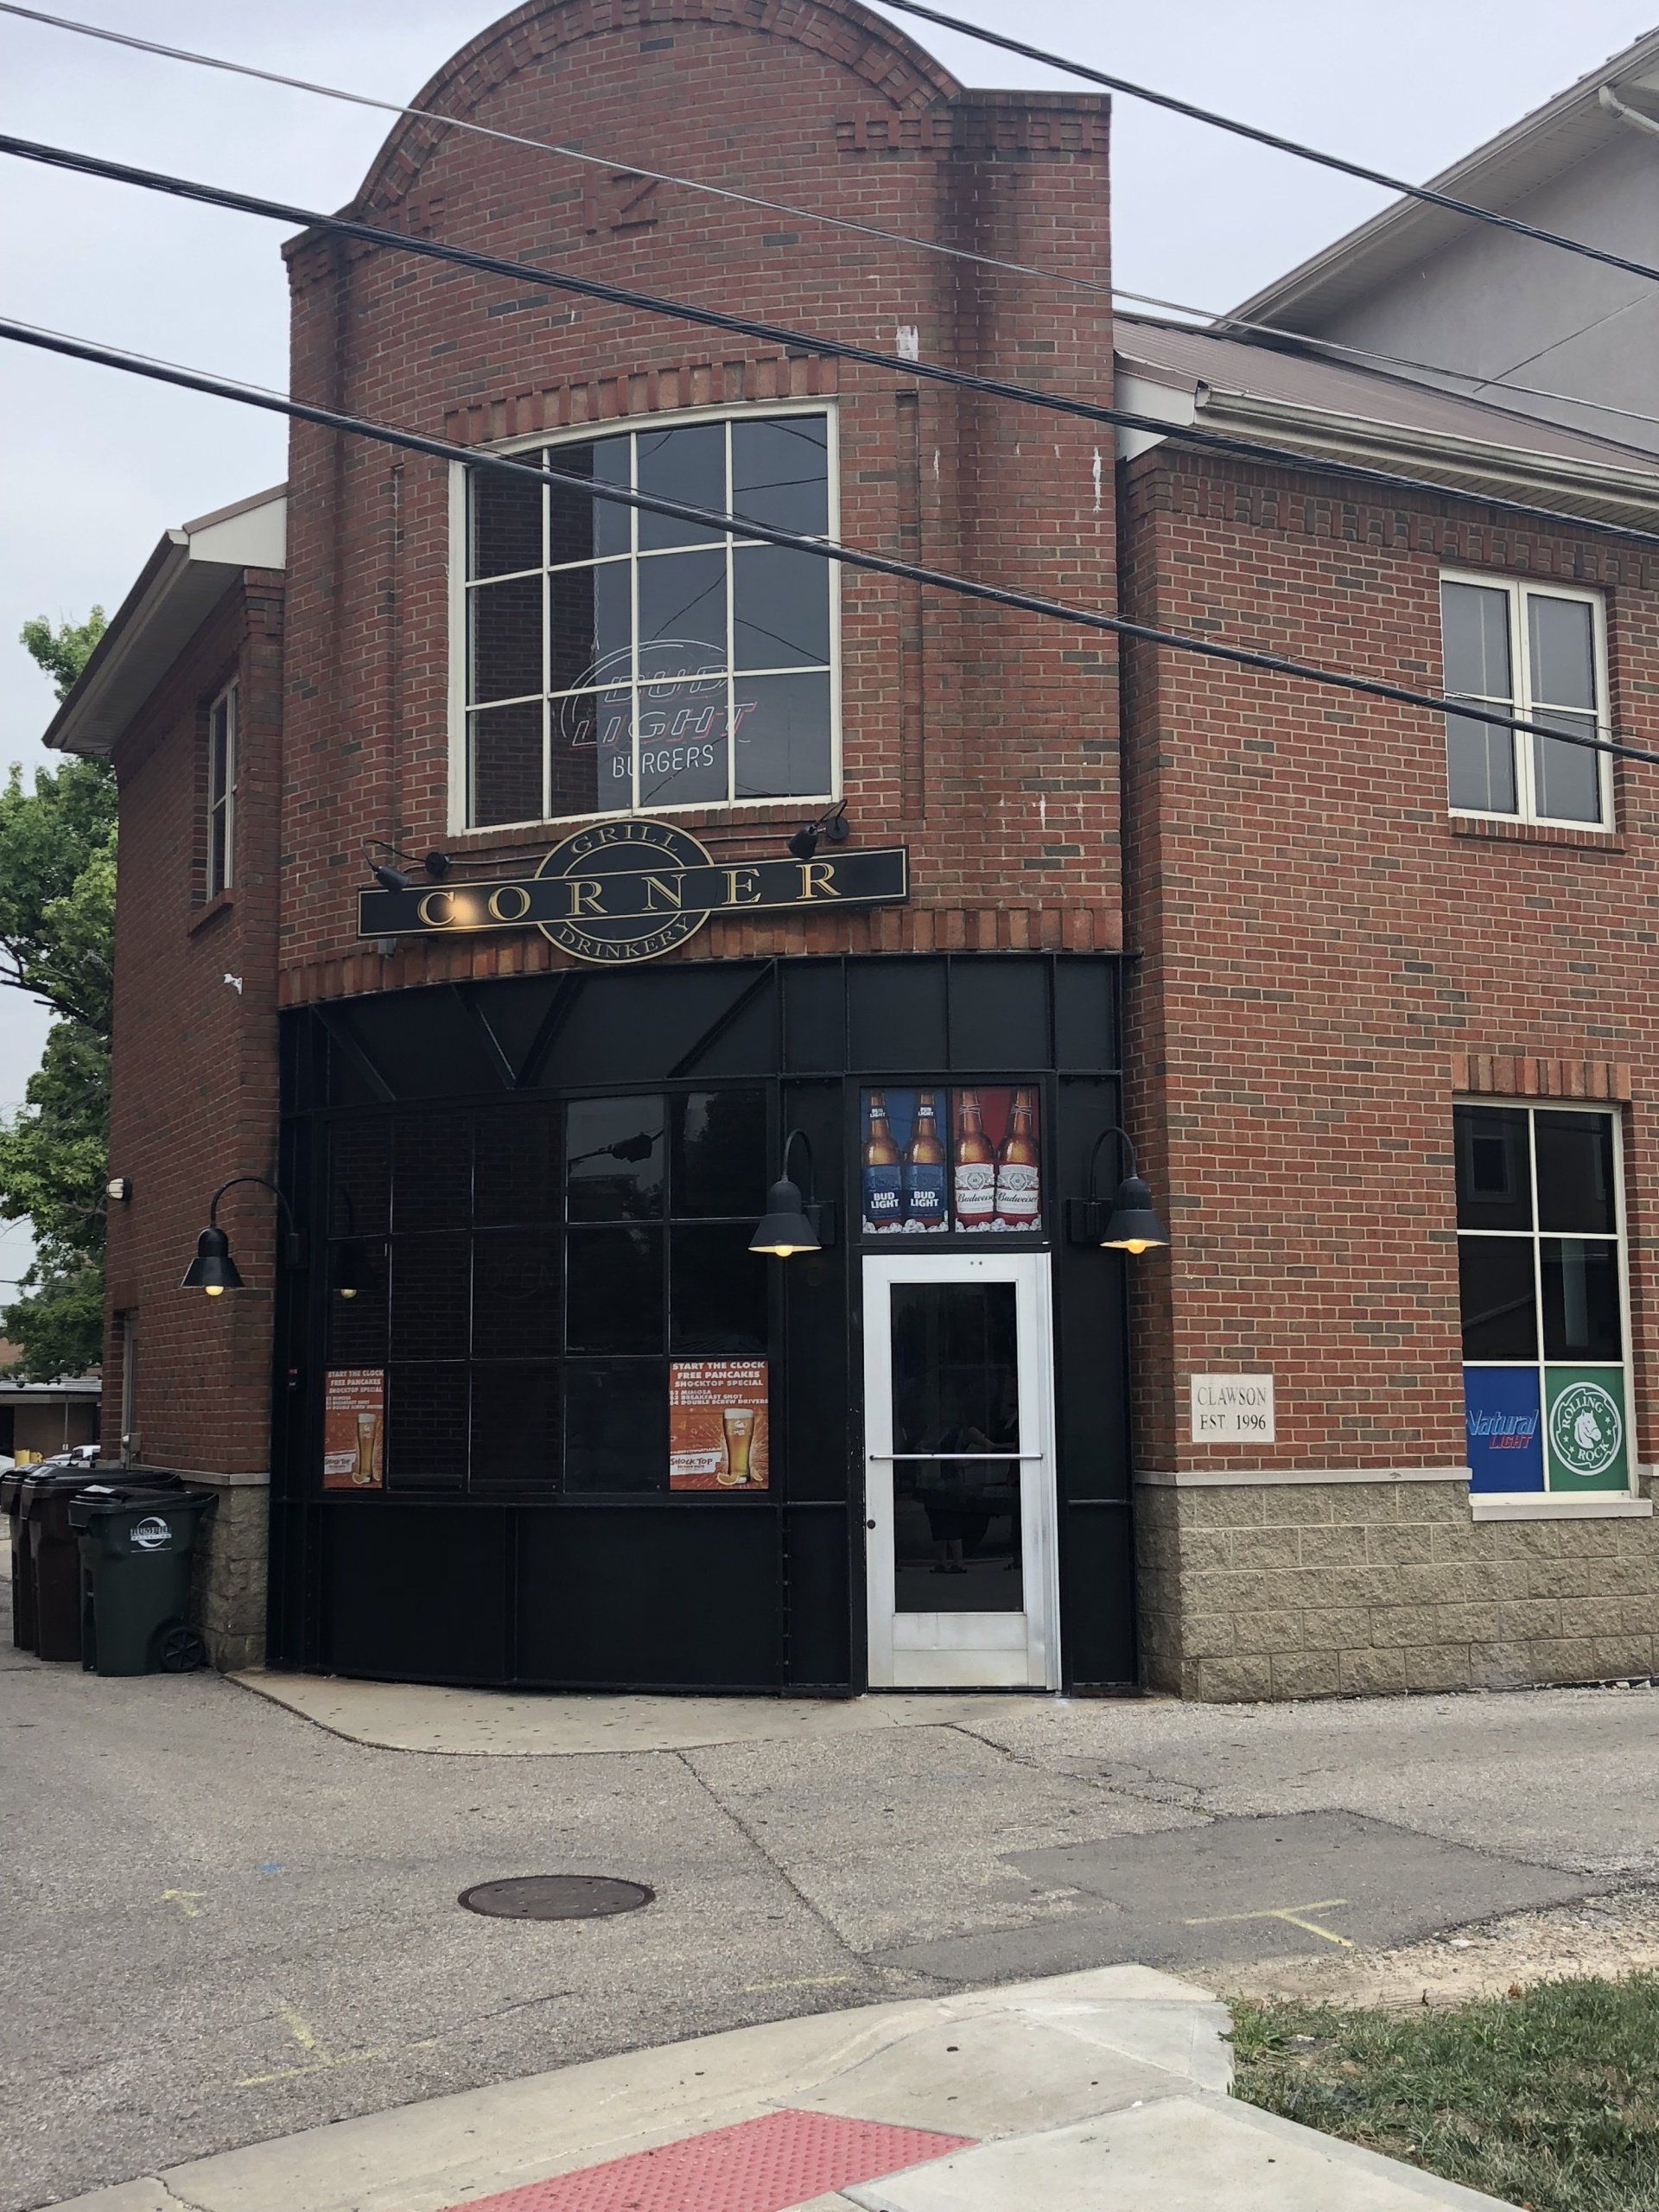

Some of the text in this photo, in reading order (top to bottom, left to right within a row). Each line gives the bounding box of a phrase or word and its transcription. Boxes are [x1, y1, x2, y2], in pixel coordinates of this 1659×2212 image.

[571, 702, 758, 750] LIGHT
[612, 744, 715, 779] BURGERS
[570, 823, 678, 855] GRILL
[417, 862, 842, 927] CORNER
[557, 918, 691, 959] DRINKERY
[870, 1199, 899, 1209] LIGHT
[873, 1192, 895, 1201] BUD
[910, 1198, 939, 1207] LIGHT
[913, 1191, 935, 1199] BUD
[704, 1370, 760, 1379] PANCAKES
[1197, 1386, 1267, 1406] CLAWSON
[1199, 1414, 1267, 1430] EST 1996
[1561, 1395, 1604, 1429] ROLLING
[1465, 1409, 1540, 1436] Natural
[1489, 1434, 1533, 1450] LIGHT
[1577, 1440, 1610, 1462] ROCK
[696, 1457, 713, 1465] TOP
